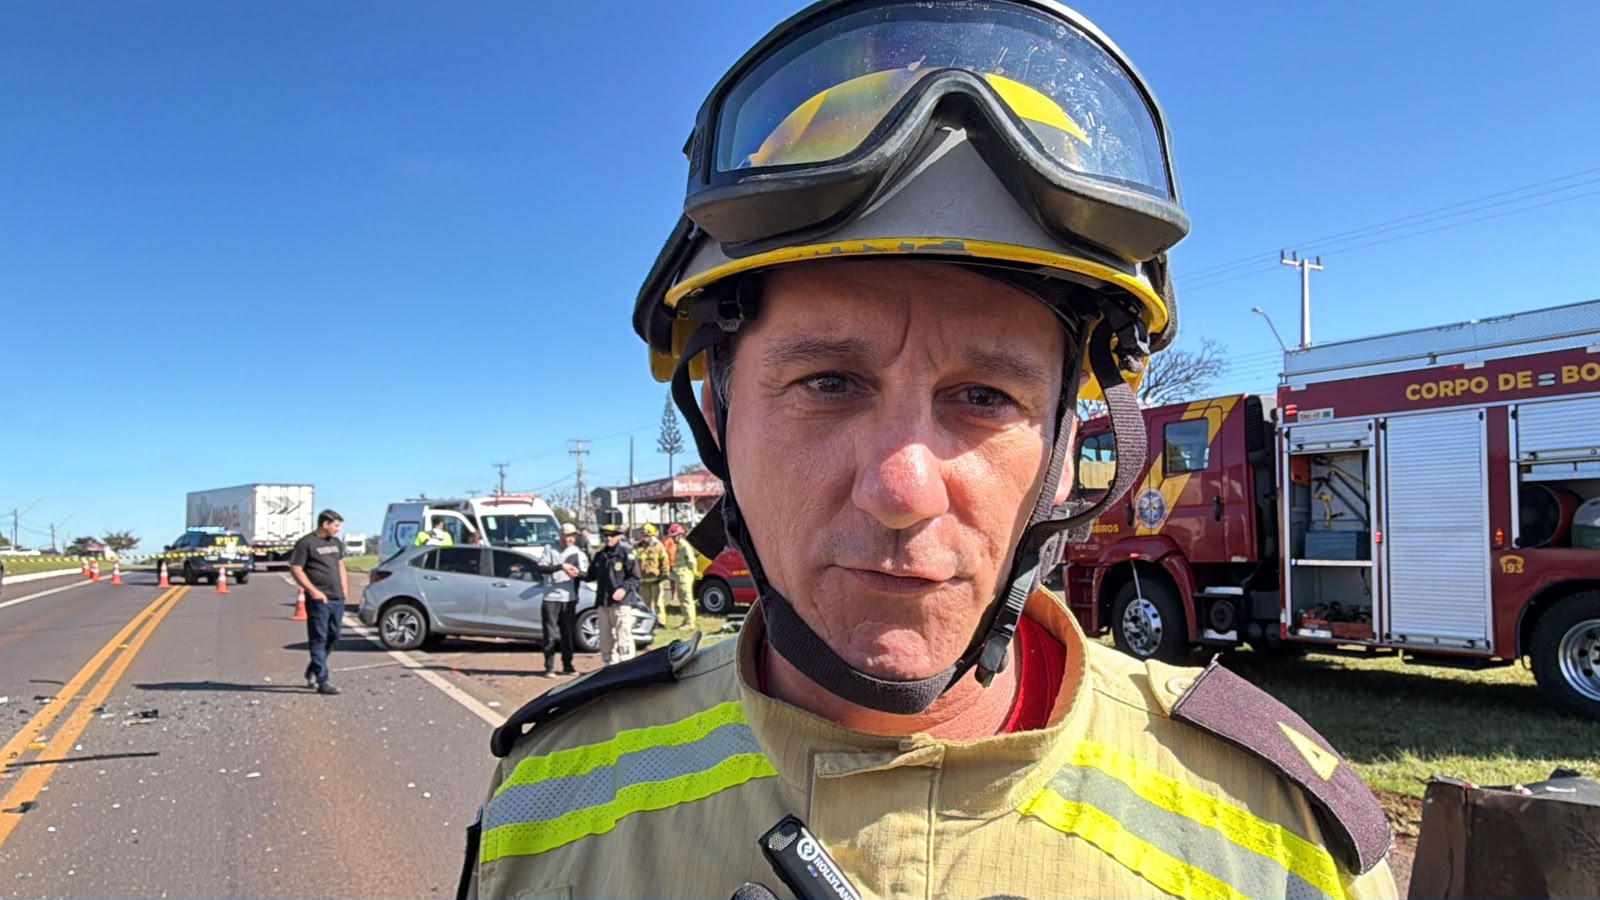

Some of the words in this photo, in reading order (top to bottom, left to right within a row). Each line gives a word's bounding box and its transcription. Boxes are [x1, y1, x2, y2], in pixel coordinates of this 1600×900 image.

[1405, 376, 1489, 401] CORPO
[1498, 370, 1533, 392] DE
[1561, 362, 1600, 385] BO
[1502, 563, 1525, 574] 193
[813, 857, 854, 900] HOLLYLAN
